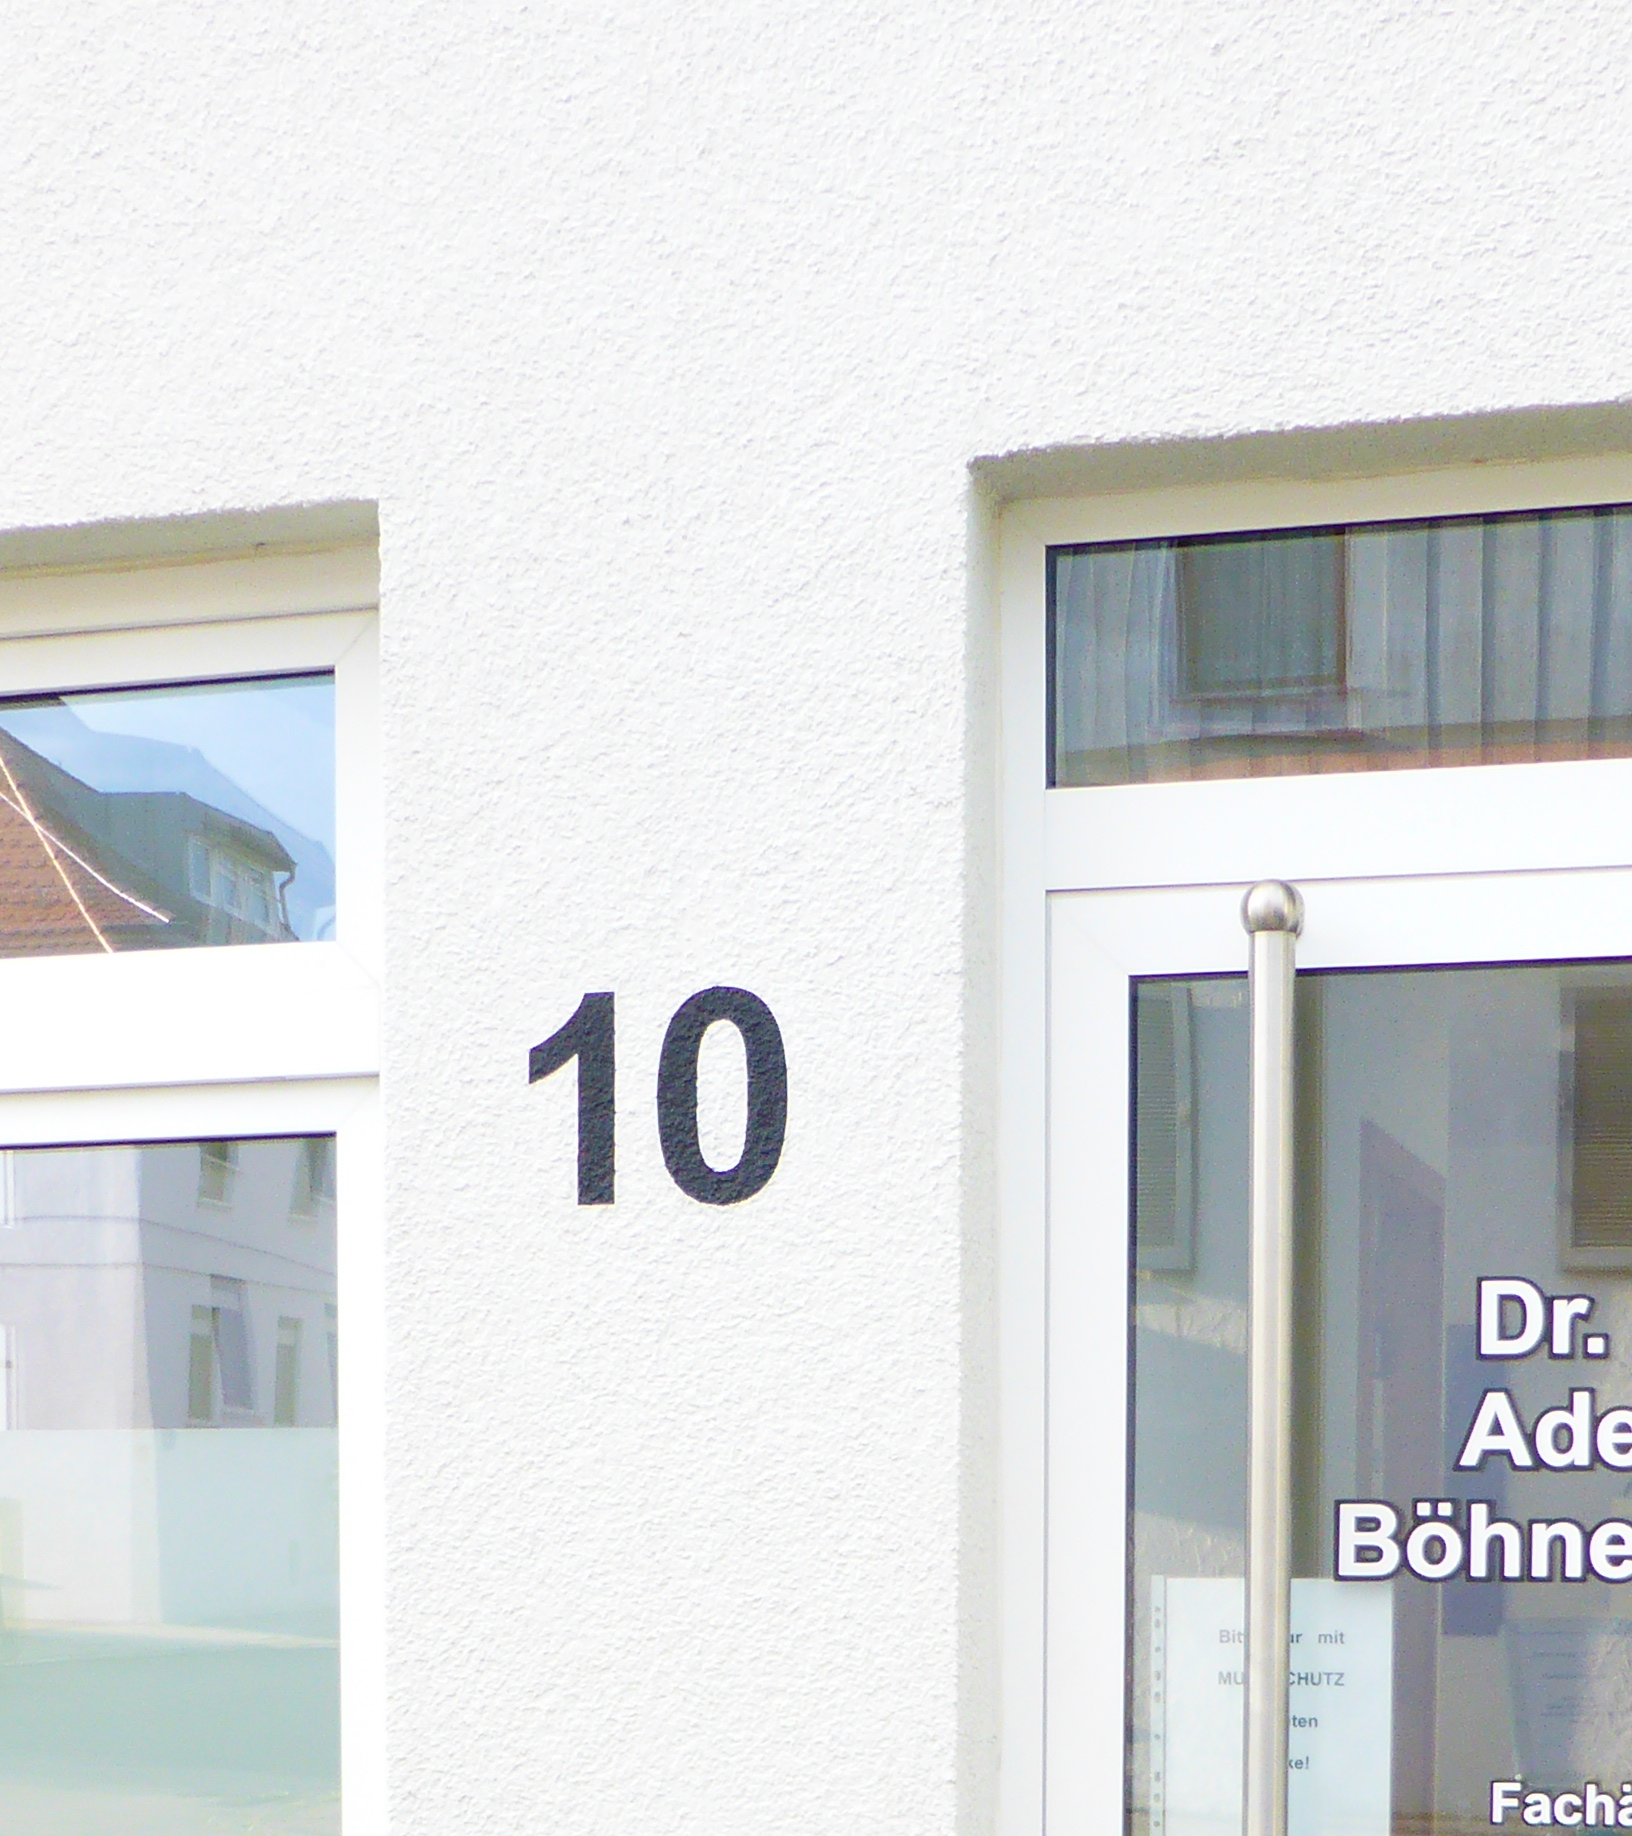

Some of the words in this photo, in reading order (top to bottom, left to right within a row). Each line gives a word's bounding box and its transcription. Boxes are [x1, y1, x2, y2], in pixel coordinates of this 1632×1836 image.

[529, 985, 788, 1206] 10
[1477, 1276, 1609, 1359] Dr.
[1318, 1630, 1345, 1645] mit
